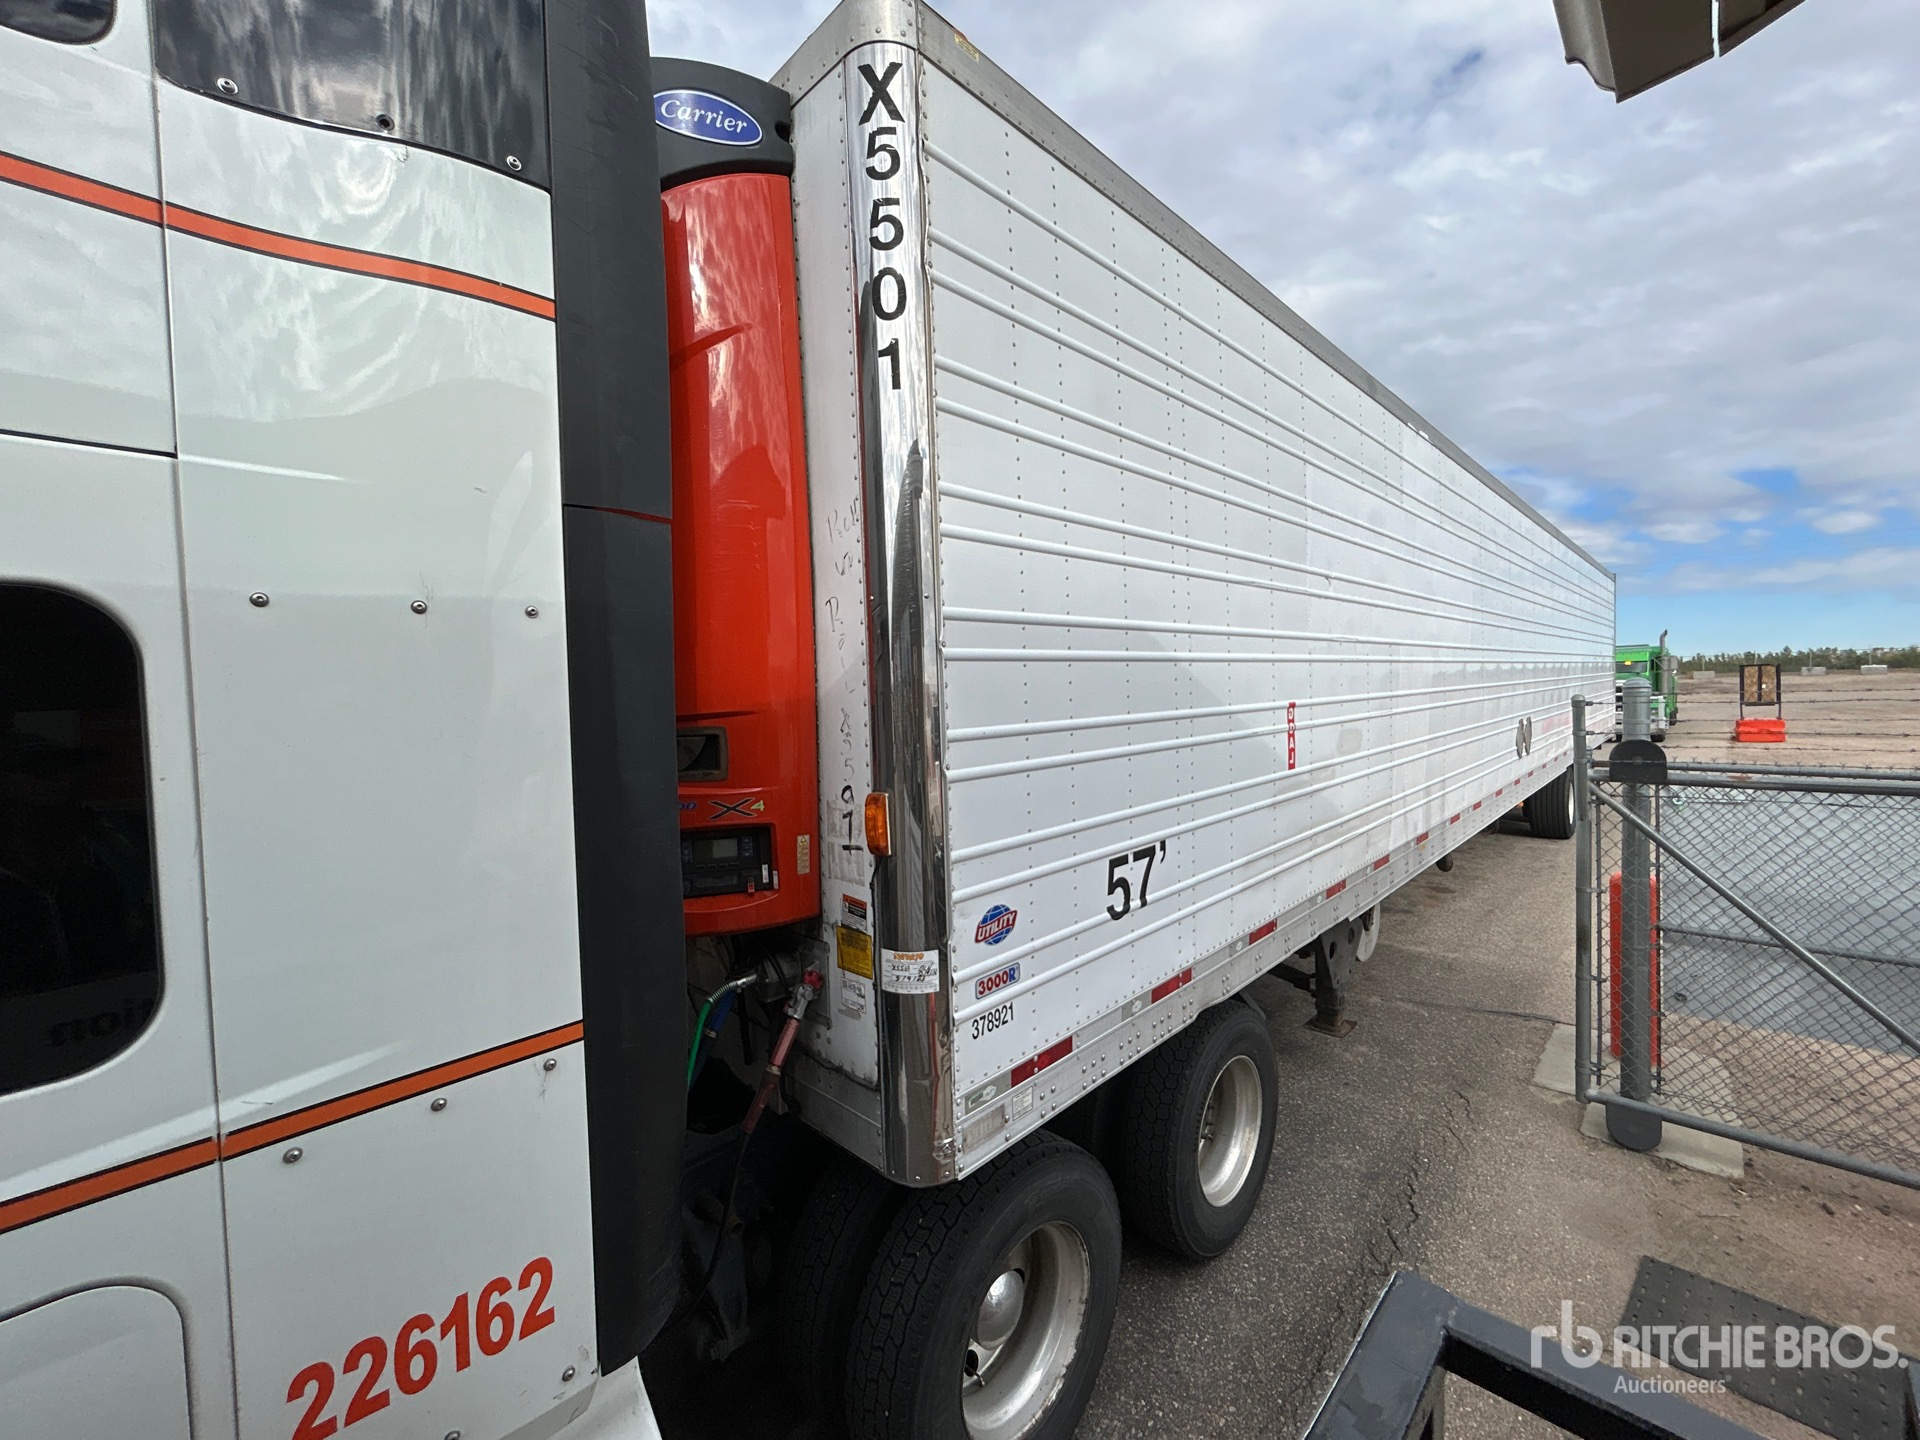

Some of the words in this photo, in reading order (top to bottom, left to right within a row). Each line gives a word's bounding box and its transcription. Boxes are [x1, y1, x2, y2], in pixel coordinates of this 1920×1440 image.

[660, 99, 748, 134] Carrier
[857, 61, 907, 391] X5501
[976, 911, 1016, 941] UTILITY
[971, 1001, 1015, 1041] 378921
[286, 1255, 555, 1440] 226162
